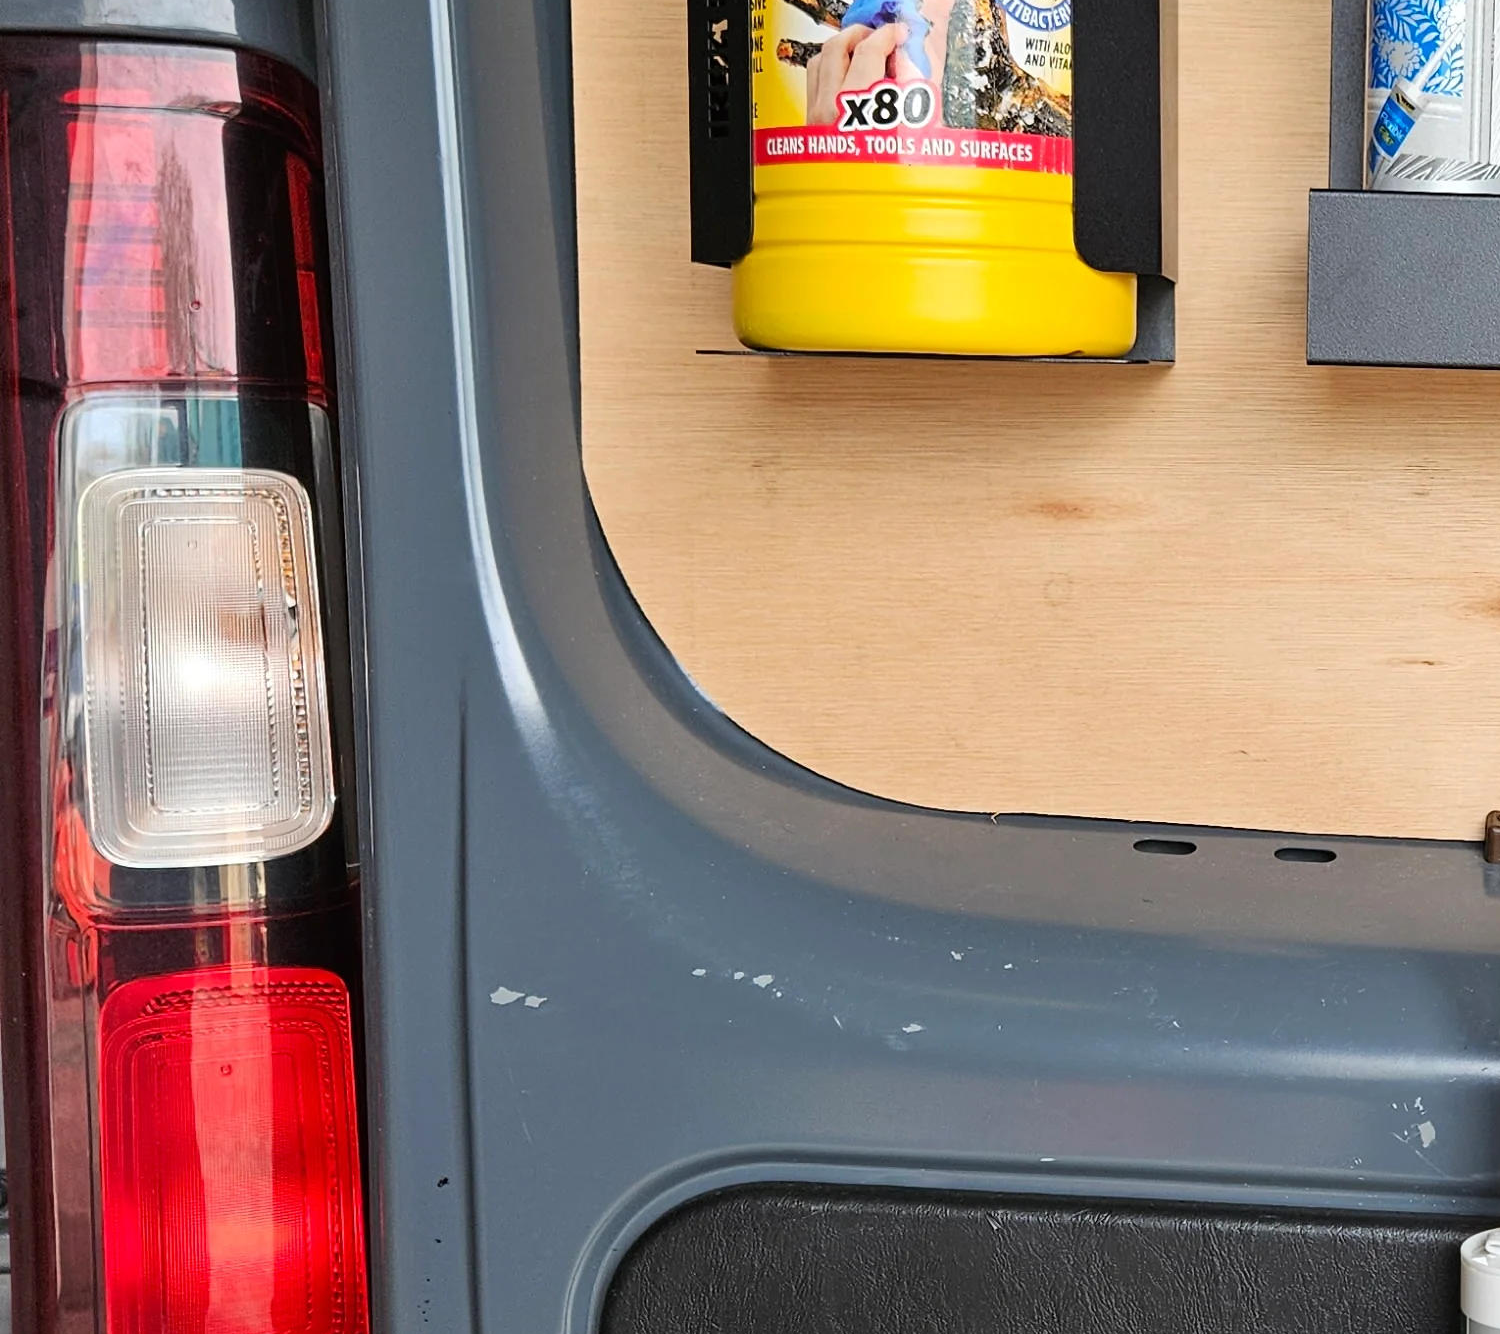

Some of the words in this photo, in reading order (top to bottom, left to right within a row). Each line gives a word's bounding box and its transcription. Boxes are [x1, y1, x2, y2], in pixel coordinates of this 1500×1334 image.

[1024, 53, 1046, 67] AND
[1049, 56, 1072, 70] VITA
[843, 86, 931, 127] x80
[766, 137, 805, 155] CLEANS
[808, 136, 861, 156] HANDS,
[865, 137, 916, 155] TOOLS
[921, 138, 955, 157] AND
[961, 140, 1033, 162] SURFACES
